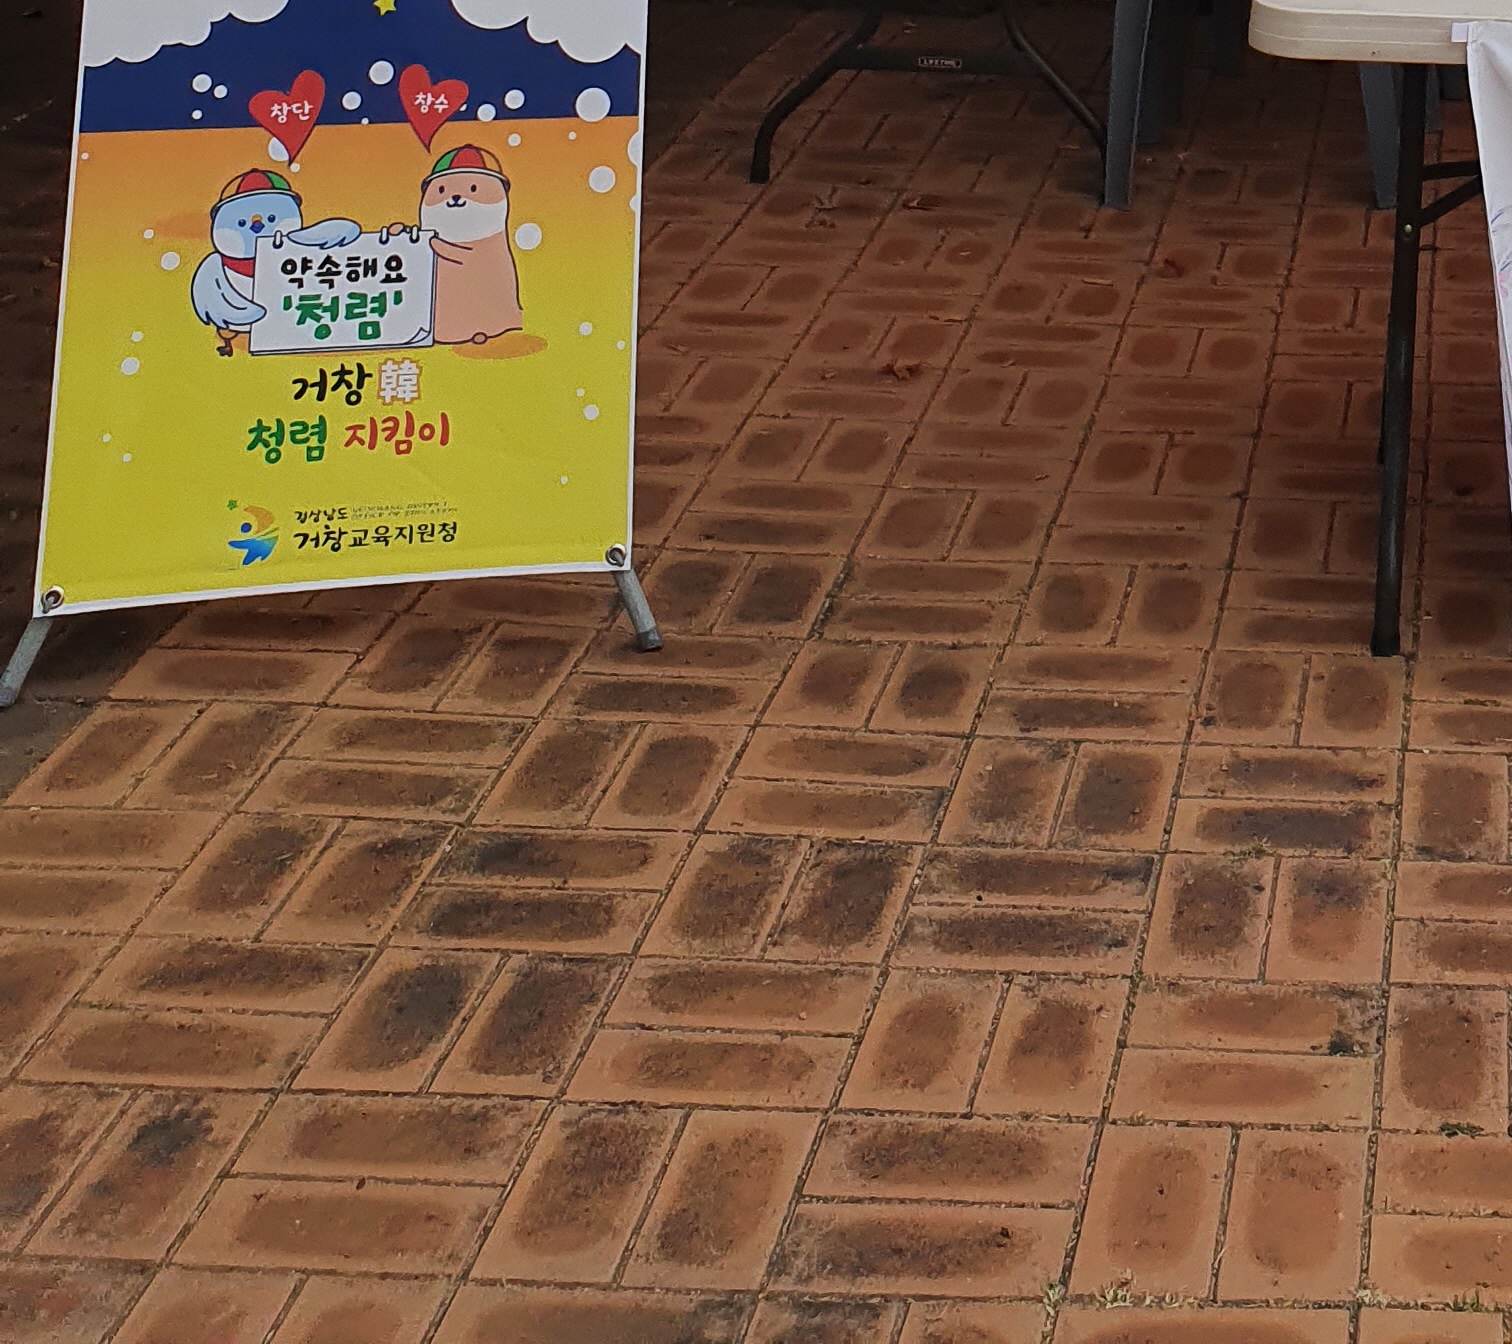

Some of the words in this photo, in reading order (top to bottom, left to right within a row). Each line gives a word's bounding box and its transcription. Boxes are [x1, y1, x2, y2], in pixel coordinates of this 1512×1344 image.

[270, 98, 314, 123] 창단
[414, 90, 450, 114] 창수
[280, 253, 408, 288] 약속해요
[246, 413, 327, 464] 청렴
[343, 410, 451, 456] 지킴이
[293, 521, 458, 553] 거창교육지원청
